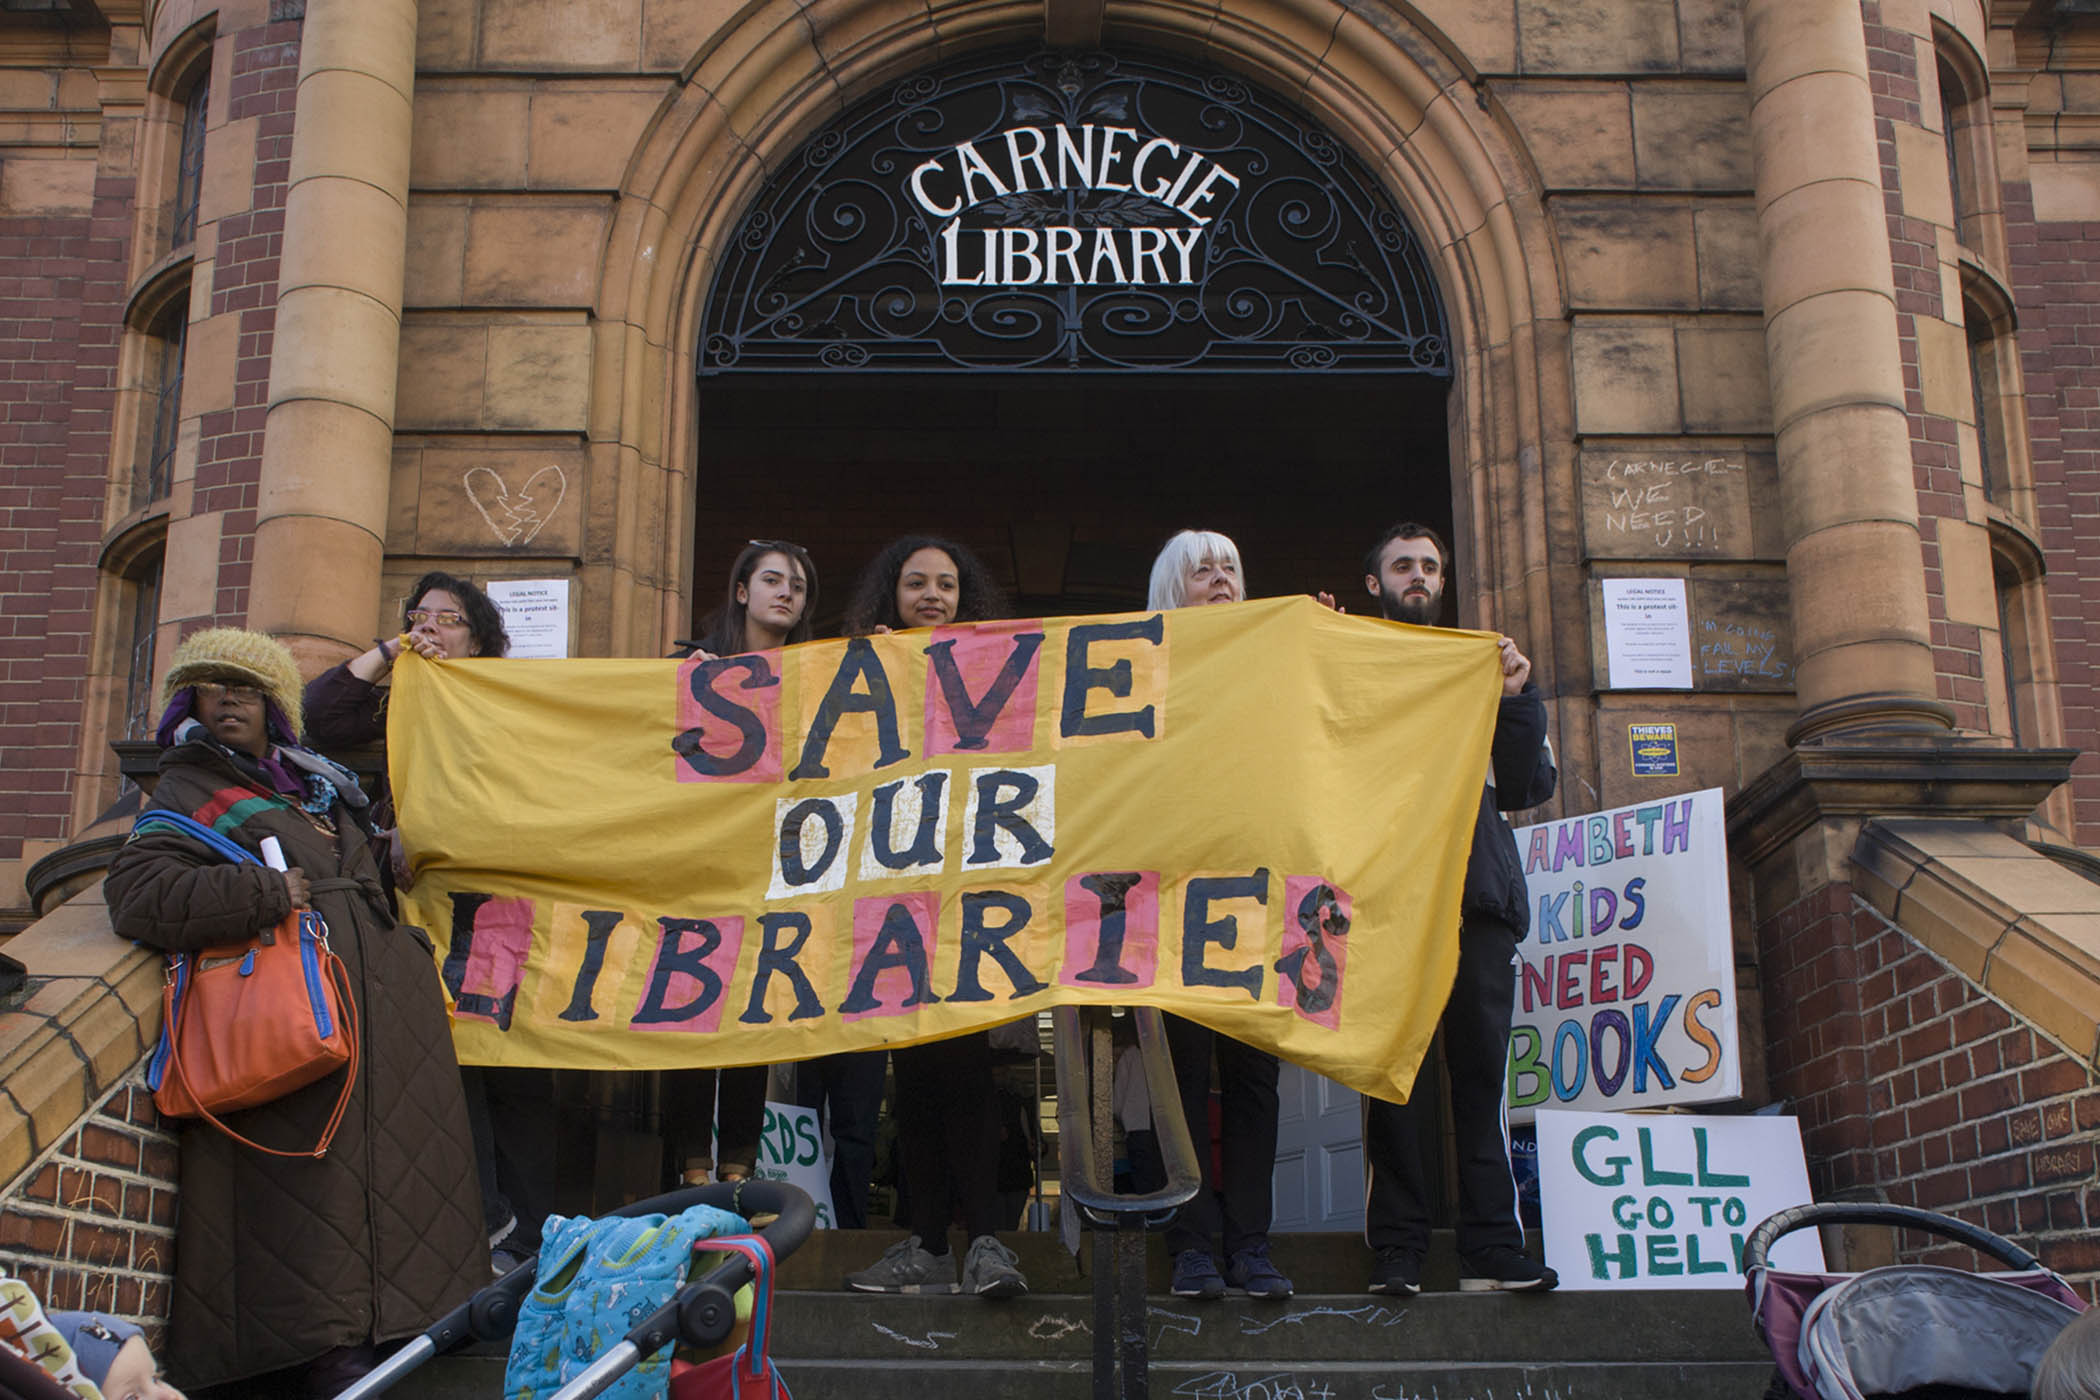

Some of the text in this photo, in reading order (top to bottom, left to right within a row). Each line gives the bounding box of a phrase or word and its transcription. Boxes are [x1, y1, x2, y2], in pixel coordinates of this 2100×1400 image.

[911, 123, 1240, 226] CARNEGIE
[941, 216, 1204, 286] LIBRARY
[1606, 505, 1706, 533] NEED
[1611, 481, 1673, 511] WE
[524, 605, 548, 613] protest
[1643, 603, 1667, 611] protest
[671, 613, 1164, 782] SAVE
[1632, 726, 1673, 734] THIEVES
[1633, 733, 1673, 741] BEWARE
[778, 769, 1055, 887] OUR
[1526, 798, 1693, 875] AMBETH
[441, 866, 1351, 1032] LIBRARIES
[1522, 943, 1655, 1013] NEED
[1508, 988, 1722, 1109] BOOKS
[1572, 1125, 1750, 1188] GLL
[1612, 1195, 1746, 1231] GO TO
